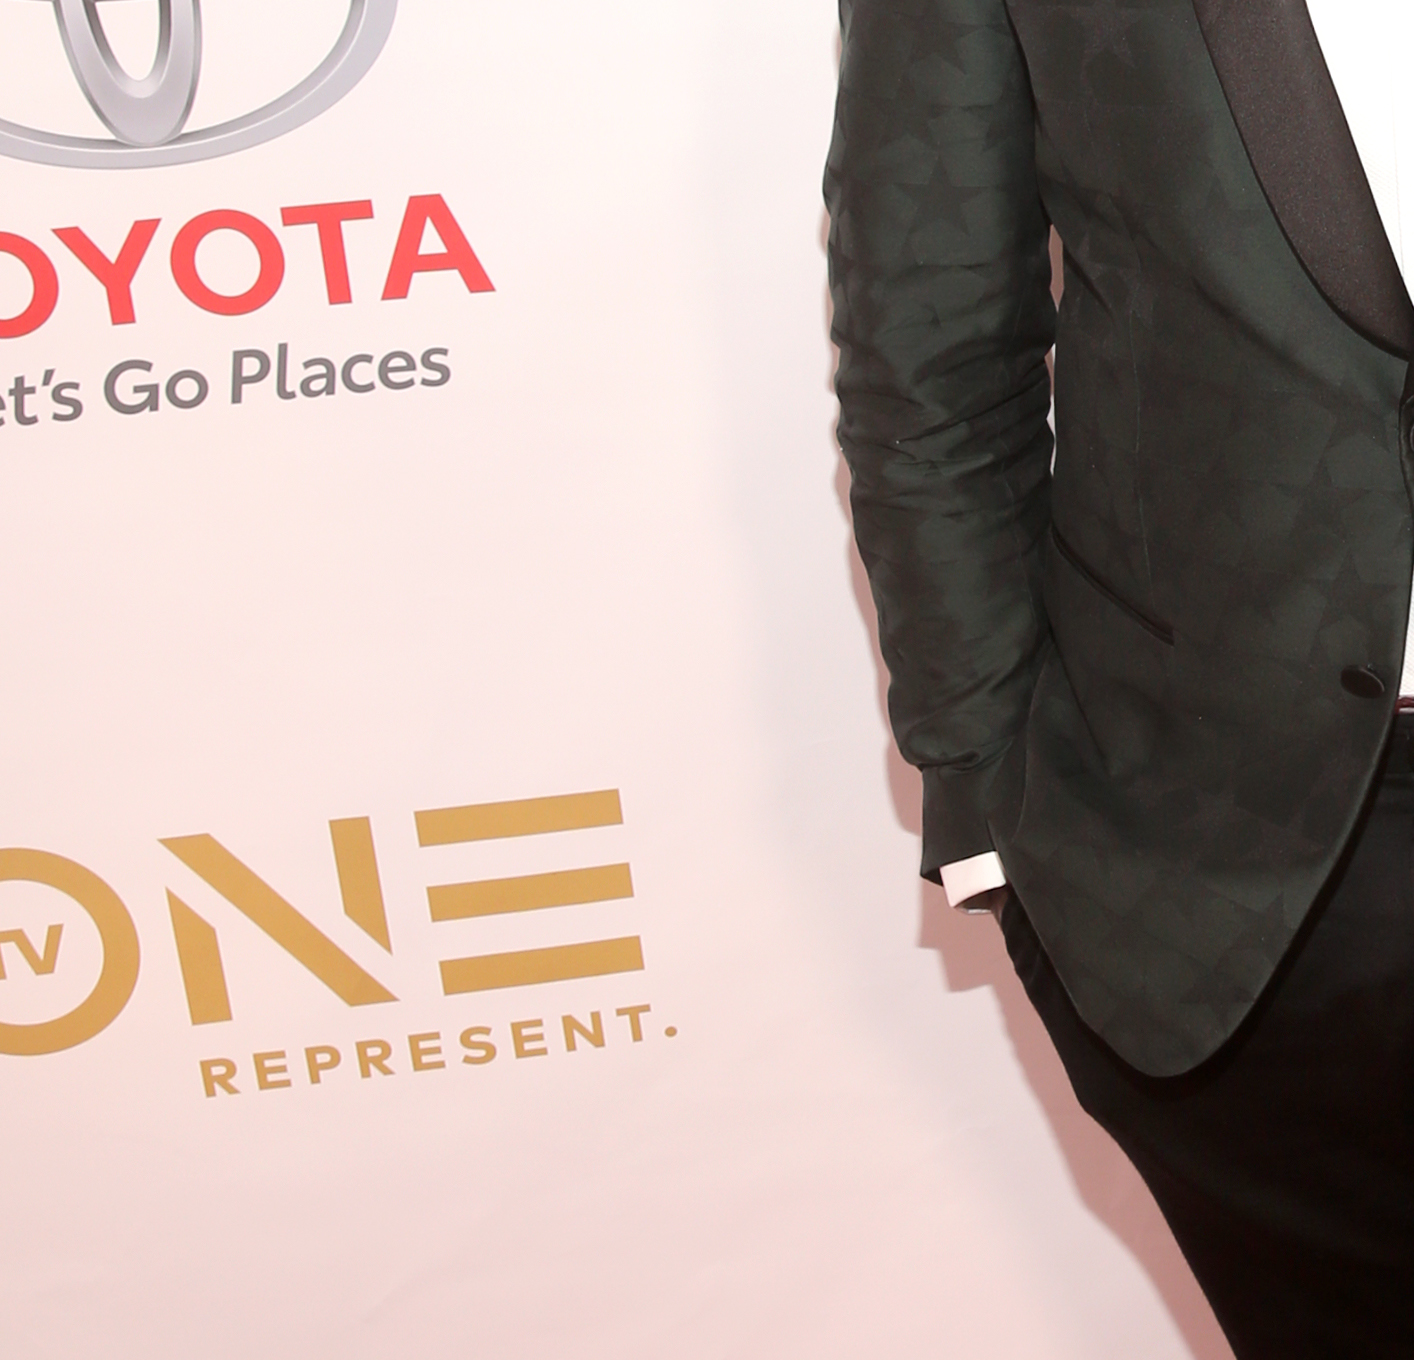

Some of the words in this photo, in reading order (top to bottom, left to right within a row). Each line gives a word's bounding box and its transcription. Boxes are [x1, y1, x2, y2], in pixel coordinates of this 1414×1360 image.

[0, 368, 83, 427] t's
[104, 359, 208, 415] Go
[230, 342, 452, 404] Places
[0, 788, 645, 1057] ONE
[199, 1003, 679, 1099] REPRESENT.
